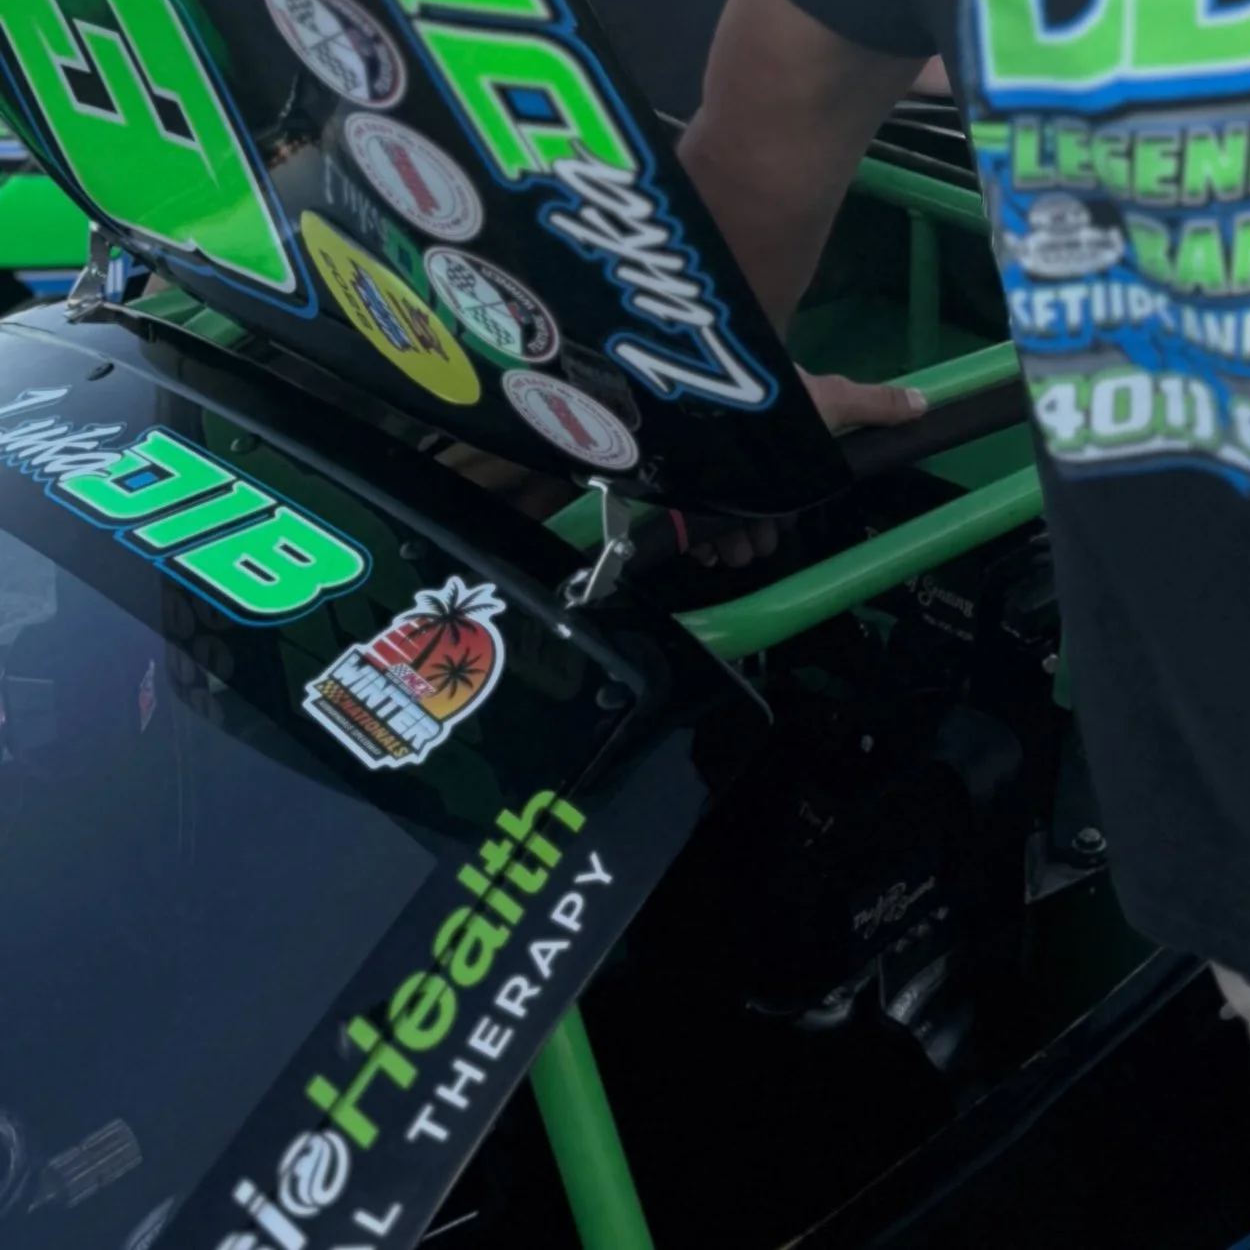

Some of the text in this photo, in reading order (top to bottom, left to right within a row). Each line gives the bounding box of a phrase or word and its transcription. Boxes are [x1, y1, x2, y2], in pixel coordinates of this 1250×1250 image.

[549, 140, 767, 403] Luka
[331, 652, 440, 750] WINTER
[340, 697, 408, 758] NATIONALS
[409, 853, 613, 1141] THERAPY
